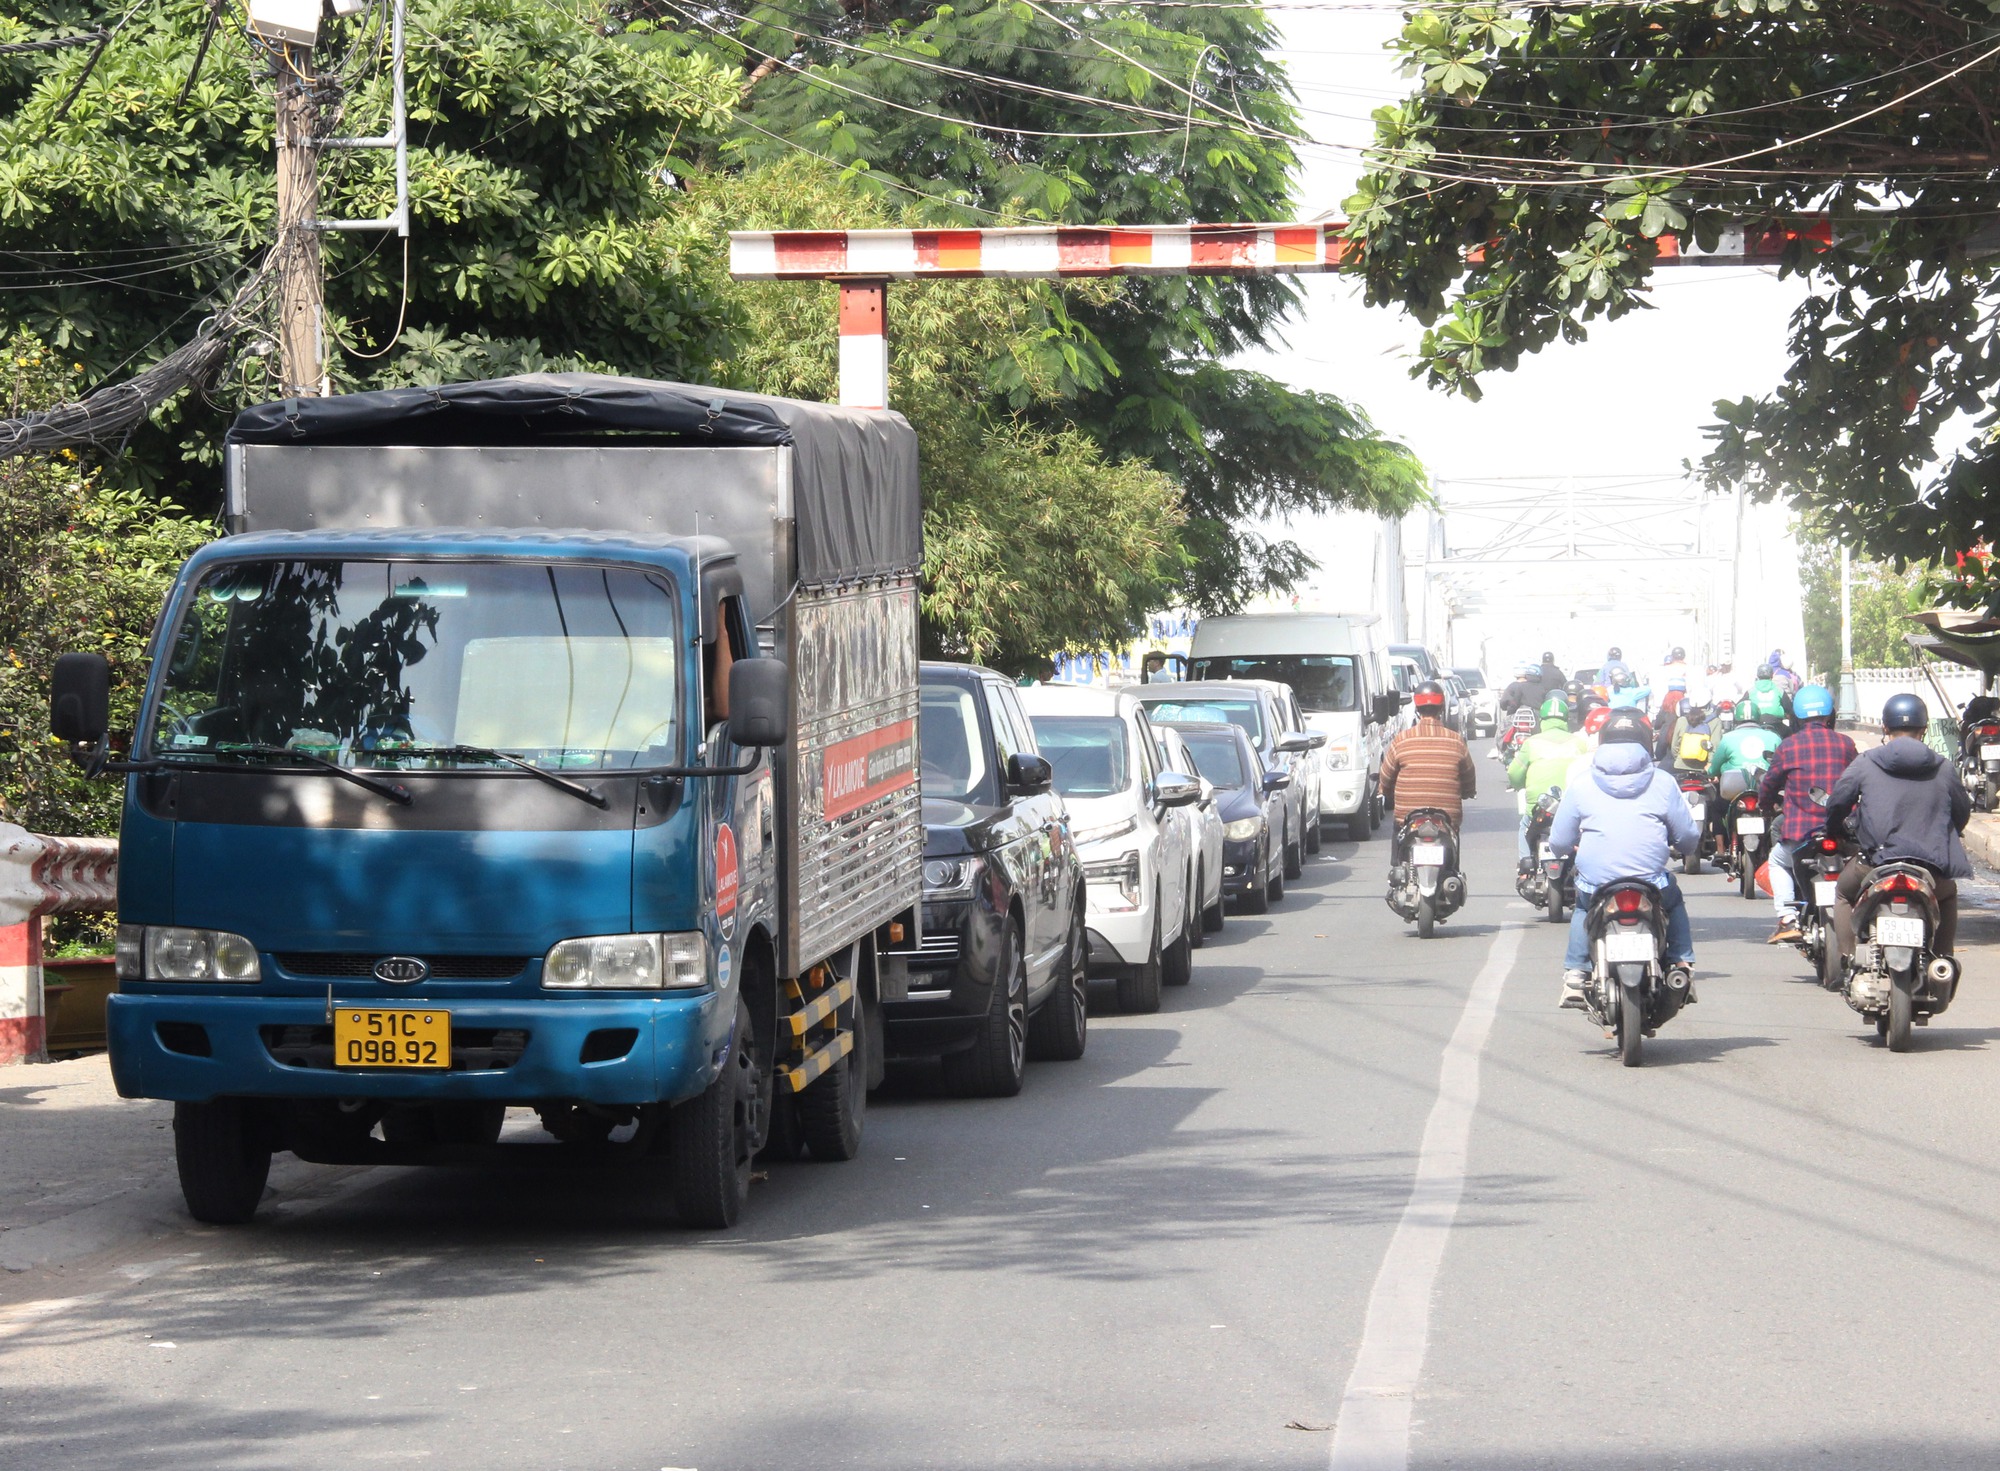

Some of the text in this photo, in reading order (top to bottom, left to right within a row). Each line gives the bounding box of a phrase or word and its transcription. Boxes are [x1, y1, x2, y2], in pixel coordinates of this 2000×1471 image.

[832, 757, 864, 798] LALAMOVE
[383, 963, 418, 977] KIA
[367, 1013, 416, 1037] 51C
[347, 1039, 437, 1064] 098.92
